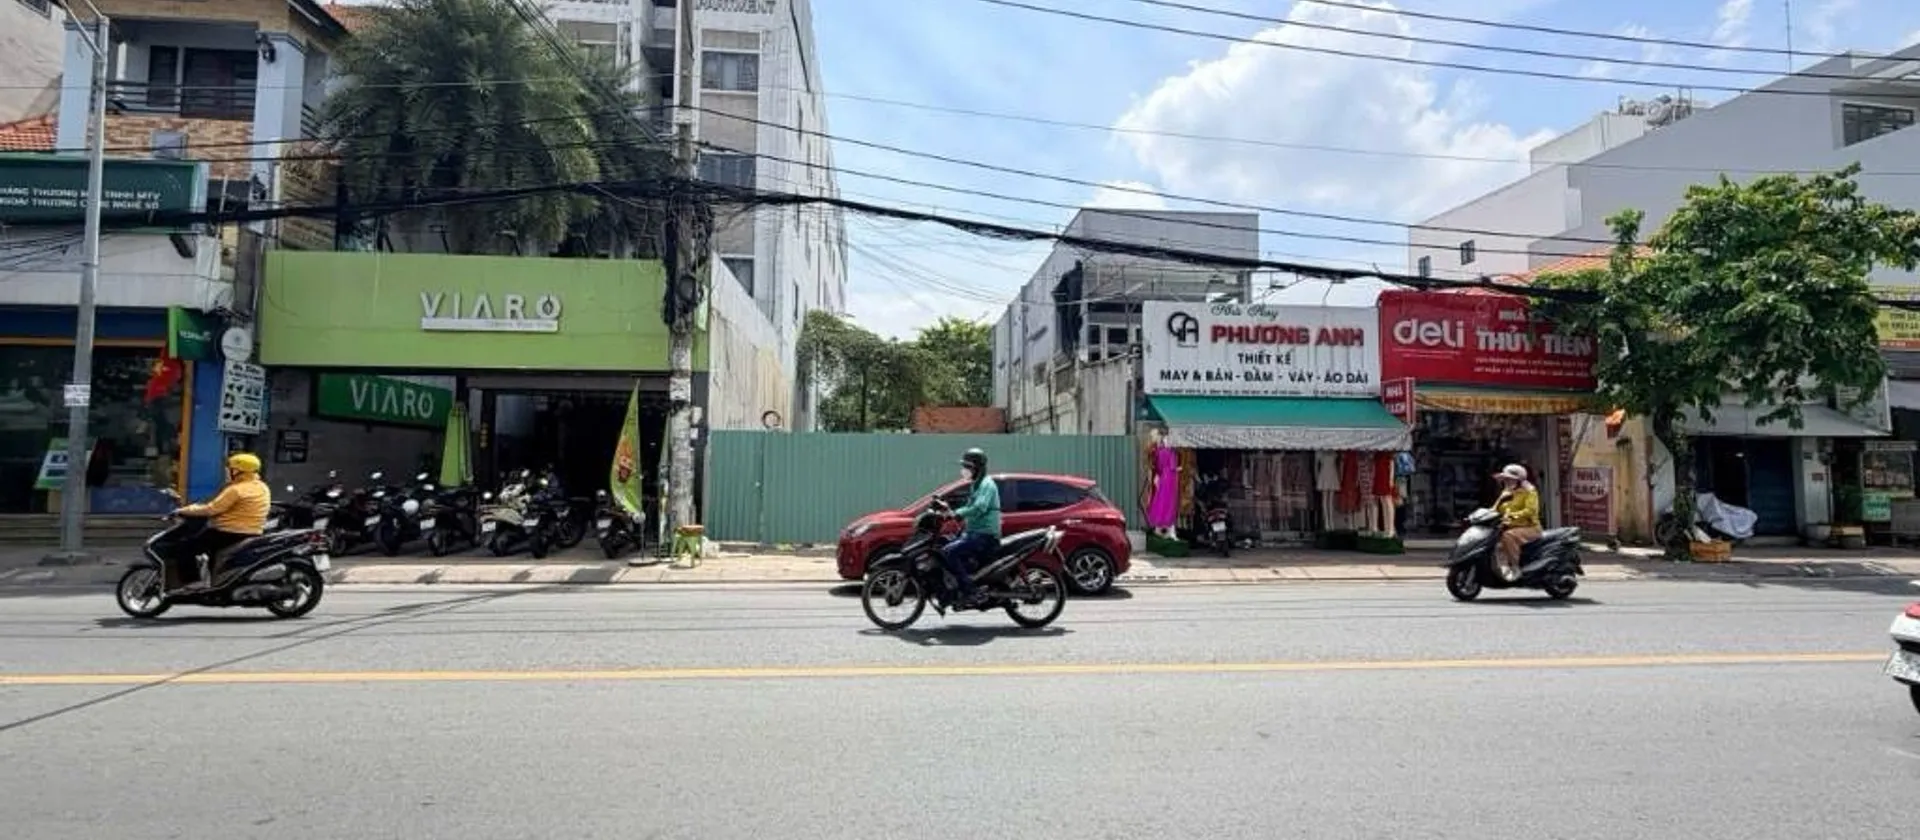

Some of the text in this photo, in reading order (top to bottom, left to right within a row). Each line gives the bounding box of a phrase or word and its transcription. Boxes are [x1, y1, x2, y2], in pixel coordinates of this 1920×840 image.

[420, 291, 562, 319] VIARO
[1211, 324, 1365, 346] PHƯƠNG ANH
[1393, 317, 1464, 348] deli
[1160, 369, 1188, 381] MAY
[349, 378, 434, 418] VIARO
